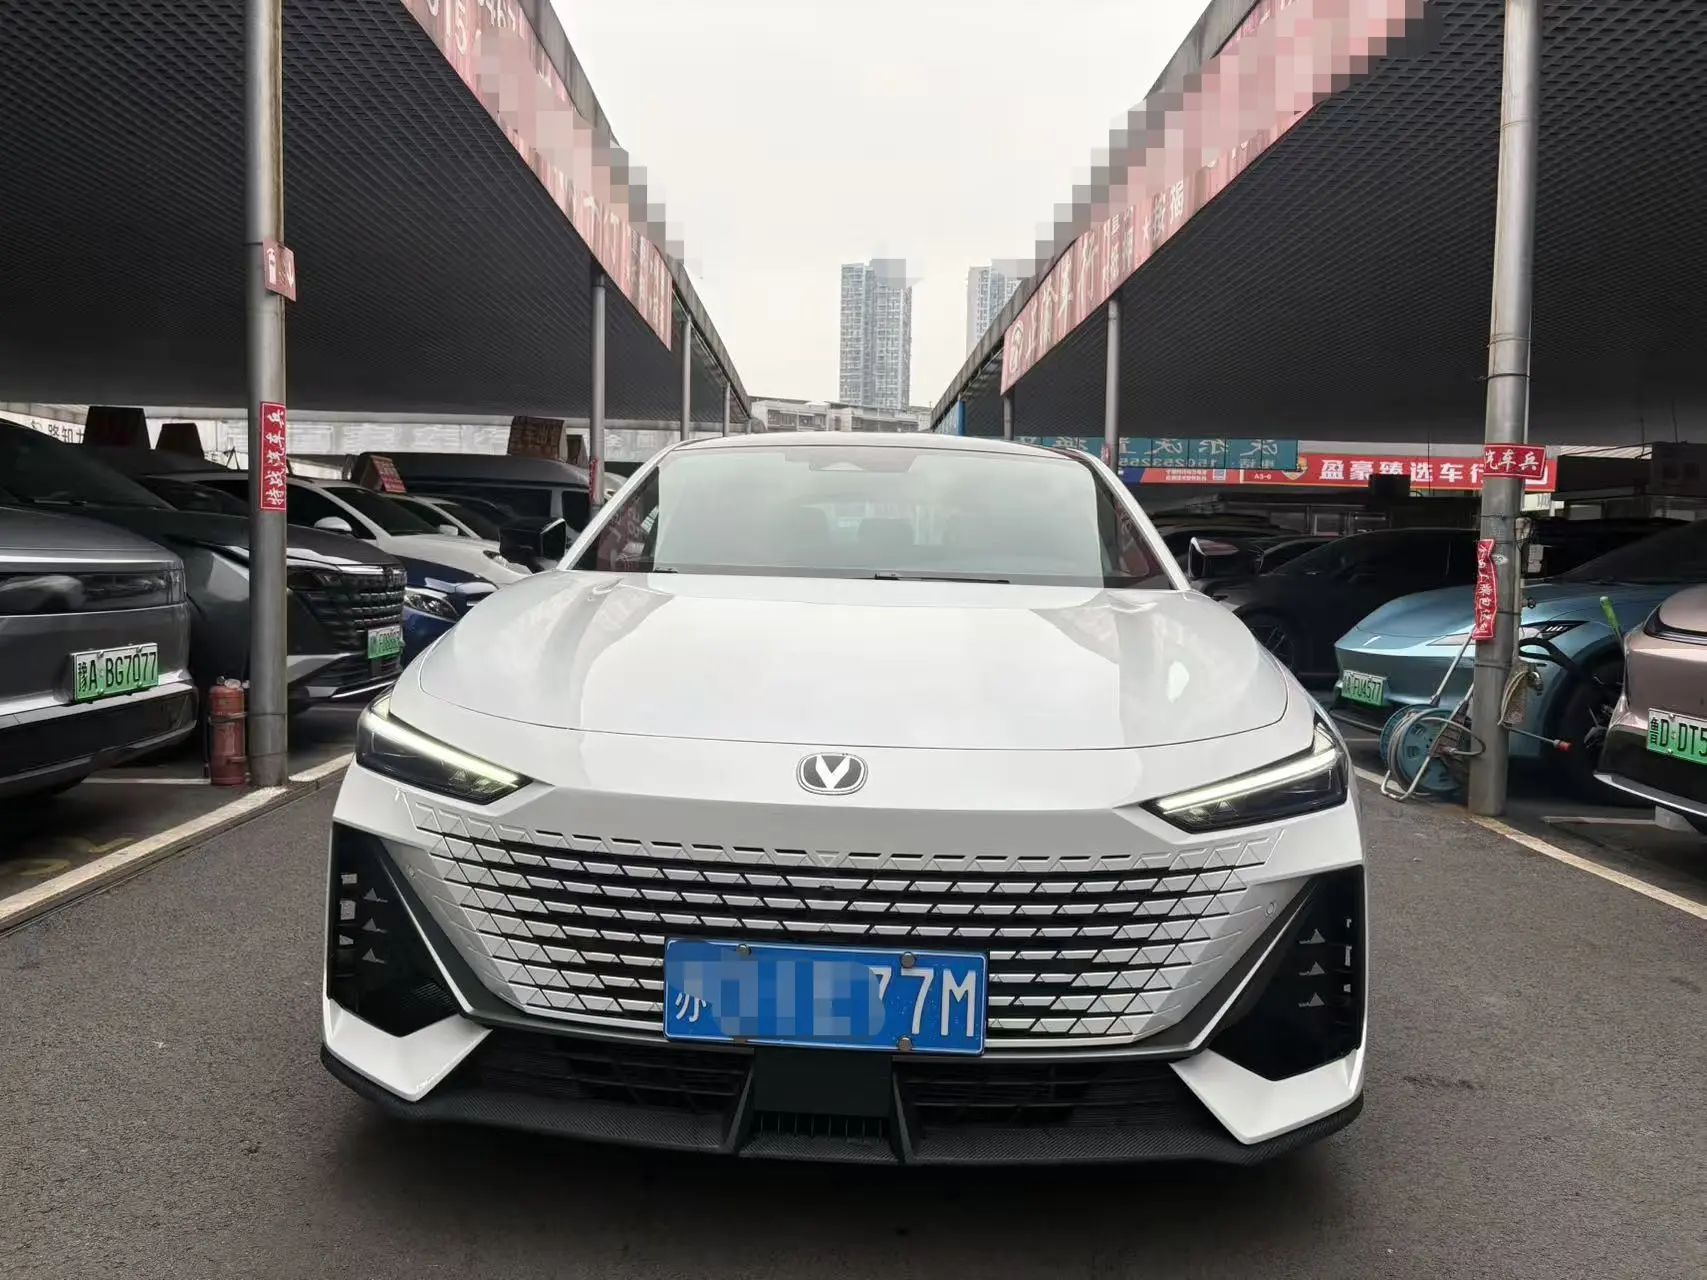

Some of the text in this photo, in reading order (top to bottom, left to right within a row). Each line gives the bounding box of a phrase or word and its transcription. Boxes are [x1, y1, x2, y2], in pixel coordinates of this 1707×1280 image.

[264, 408, 286, 506] 特战汽车兵
[1485, 448, 1539, 472] 汽车兵
